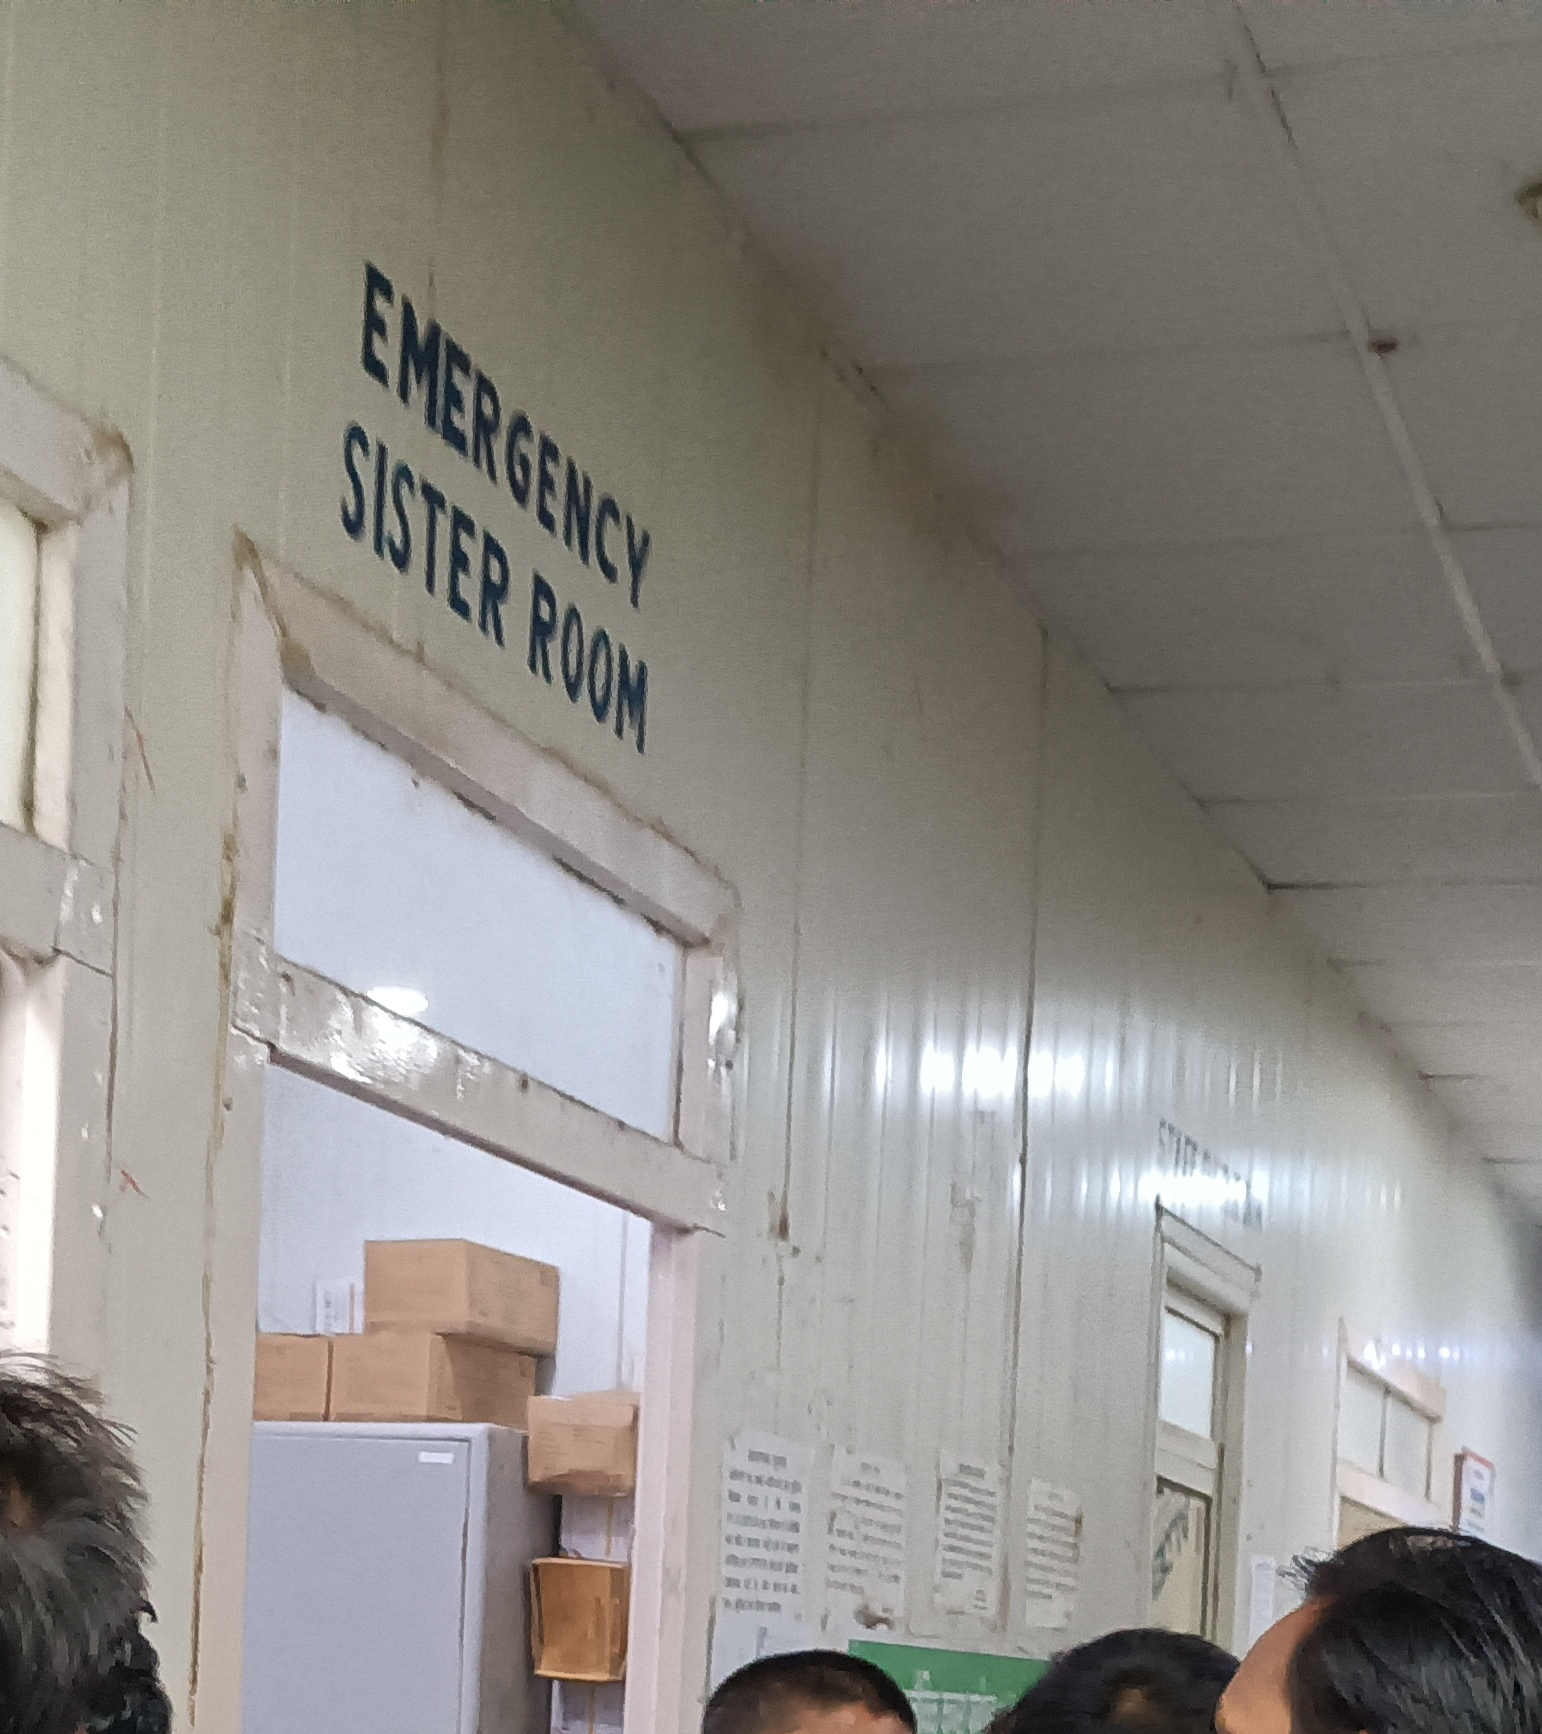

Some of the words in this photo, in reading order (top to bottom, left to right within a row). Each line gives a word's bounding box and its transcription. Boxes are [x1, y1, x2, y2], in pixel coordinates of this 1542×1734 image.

[340, 419, 511, 649] SISTER
[527, 569, 650, 756] ROOM
[360, 260, 652, 610] EMERGENCY
